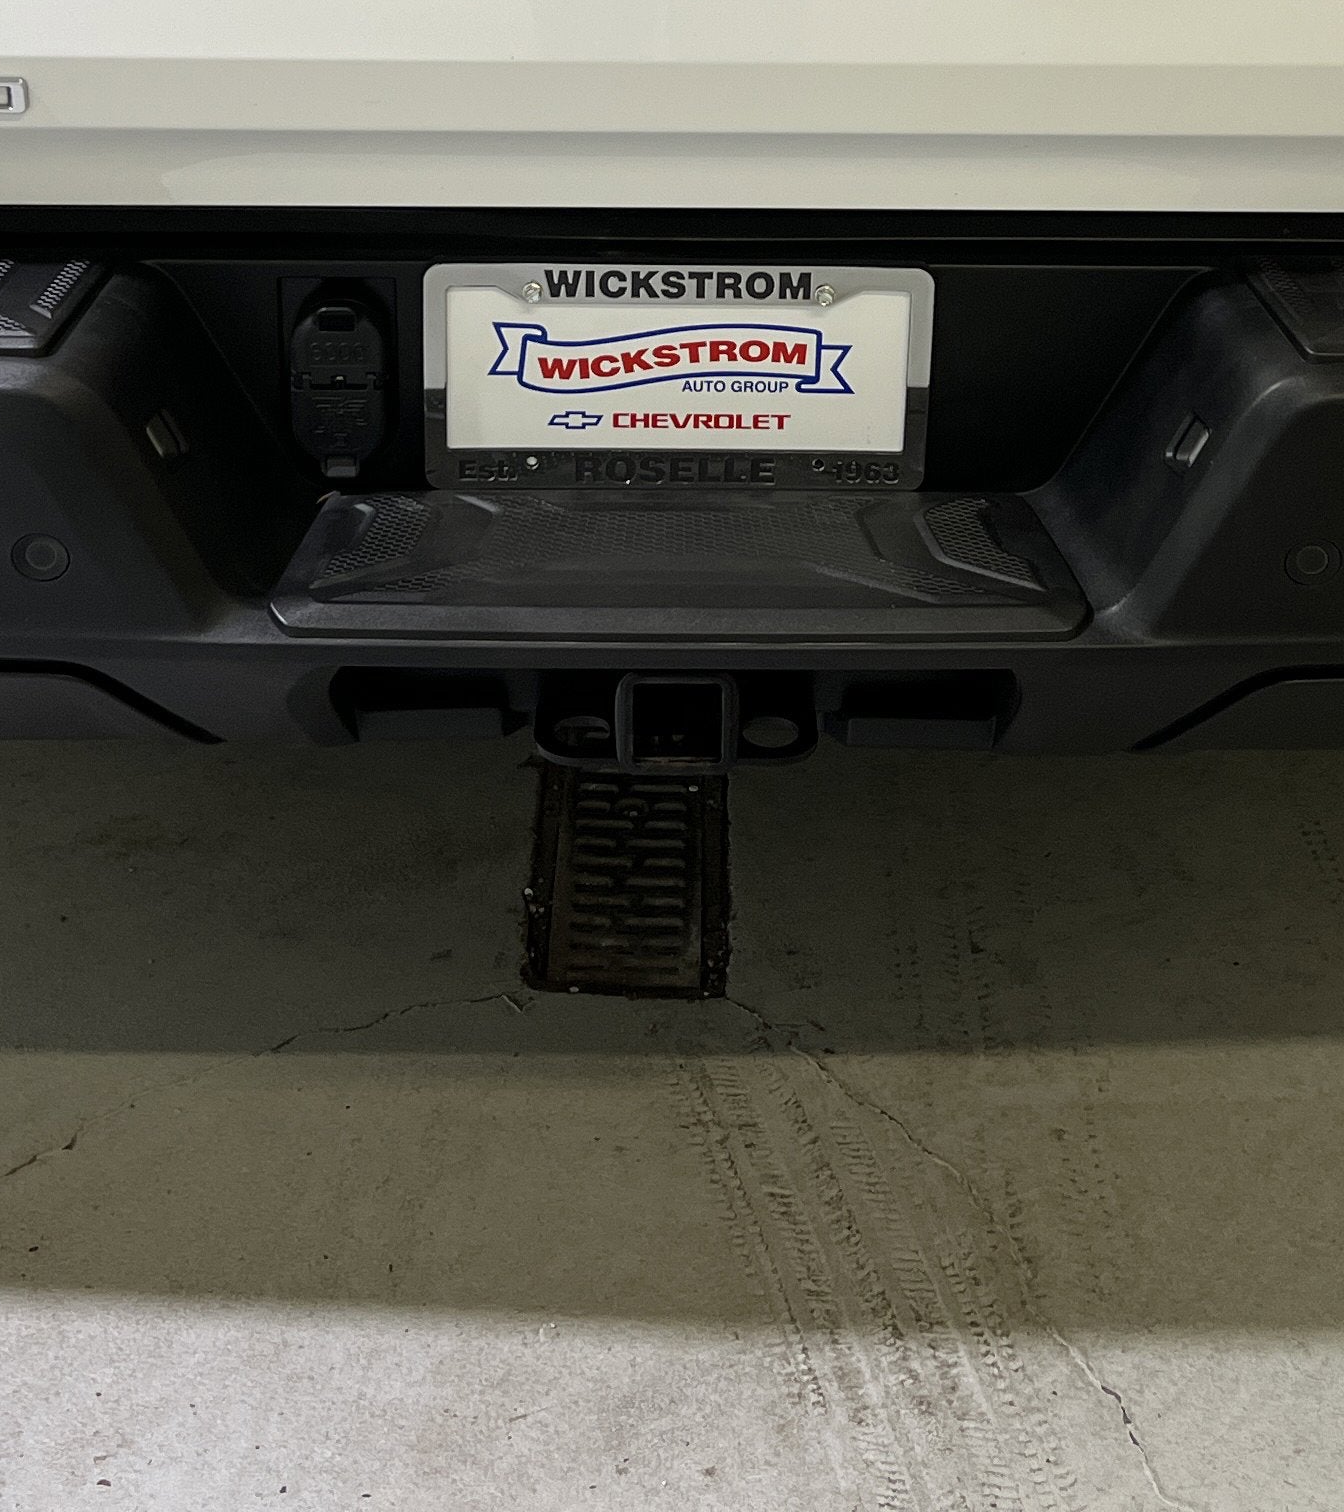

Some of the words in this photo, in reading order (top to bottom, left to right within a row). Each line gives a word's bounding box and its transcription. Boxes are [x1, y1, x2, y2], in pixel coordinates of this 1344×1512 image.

[544, 269, 813, 301] WICKSTROM
[537, 339, 809, 381] WICKSTROM
[682, 380, 726, 393] AUTO
[730, 380, 789, 394] GROUP
[612, 412, 792, 430] CHEVROLET
[574, 455, 776, 485] ROSELLE
